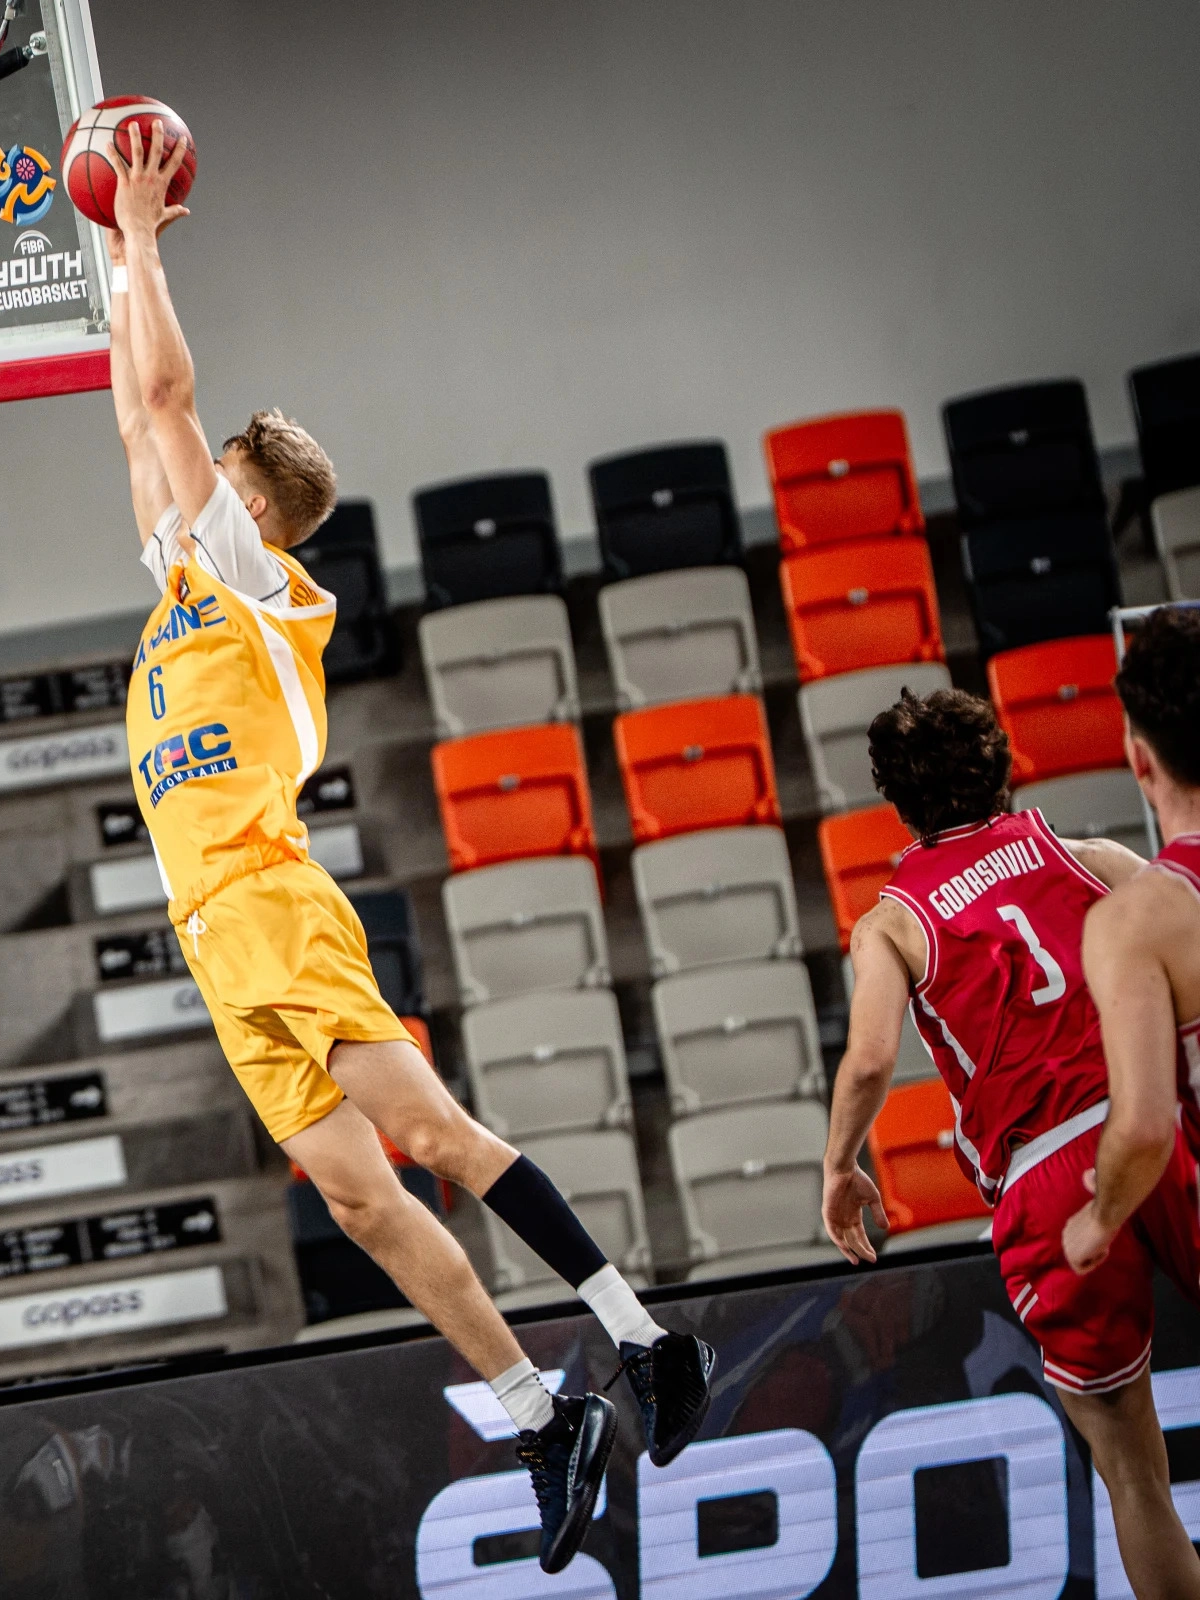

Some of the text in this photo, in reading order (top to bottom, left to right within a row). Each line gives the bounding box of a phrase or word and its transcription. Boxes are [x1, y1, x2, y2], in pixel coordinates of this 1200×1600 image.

[20, 239, 45, 255] FIBA
[132, 594, 227, 673] AINE
[148, 665, 166, 720] 6
[928, 837, 1046, 920] GORASHVILI
[996, 904, 1067, 1006] 3
[415, 1366, 1200, 1600] ŠPO
